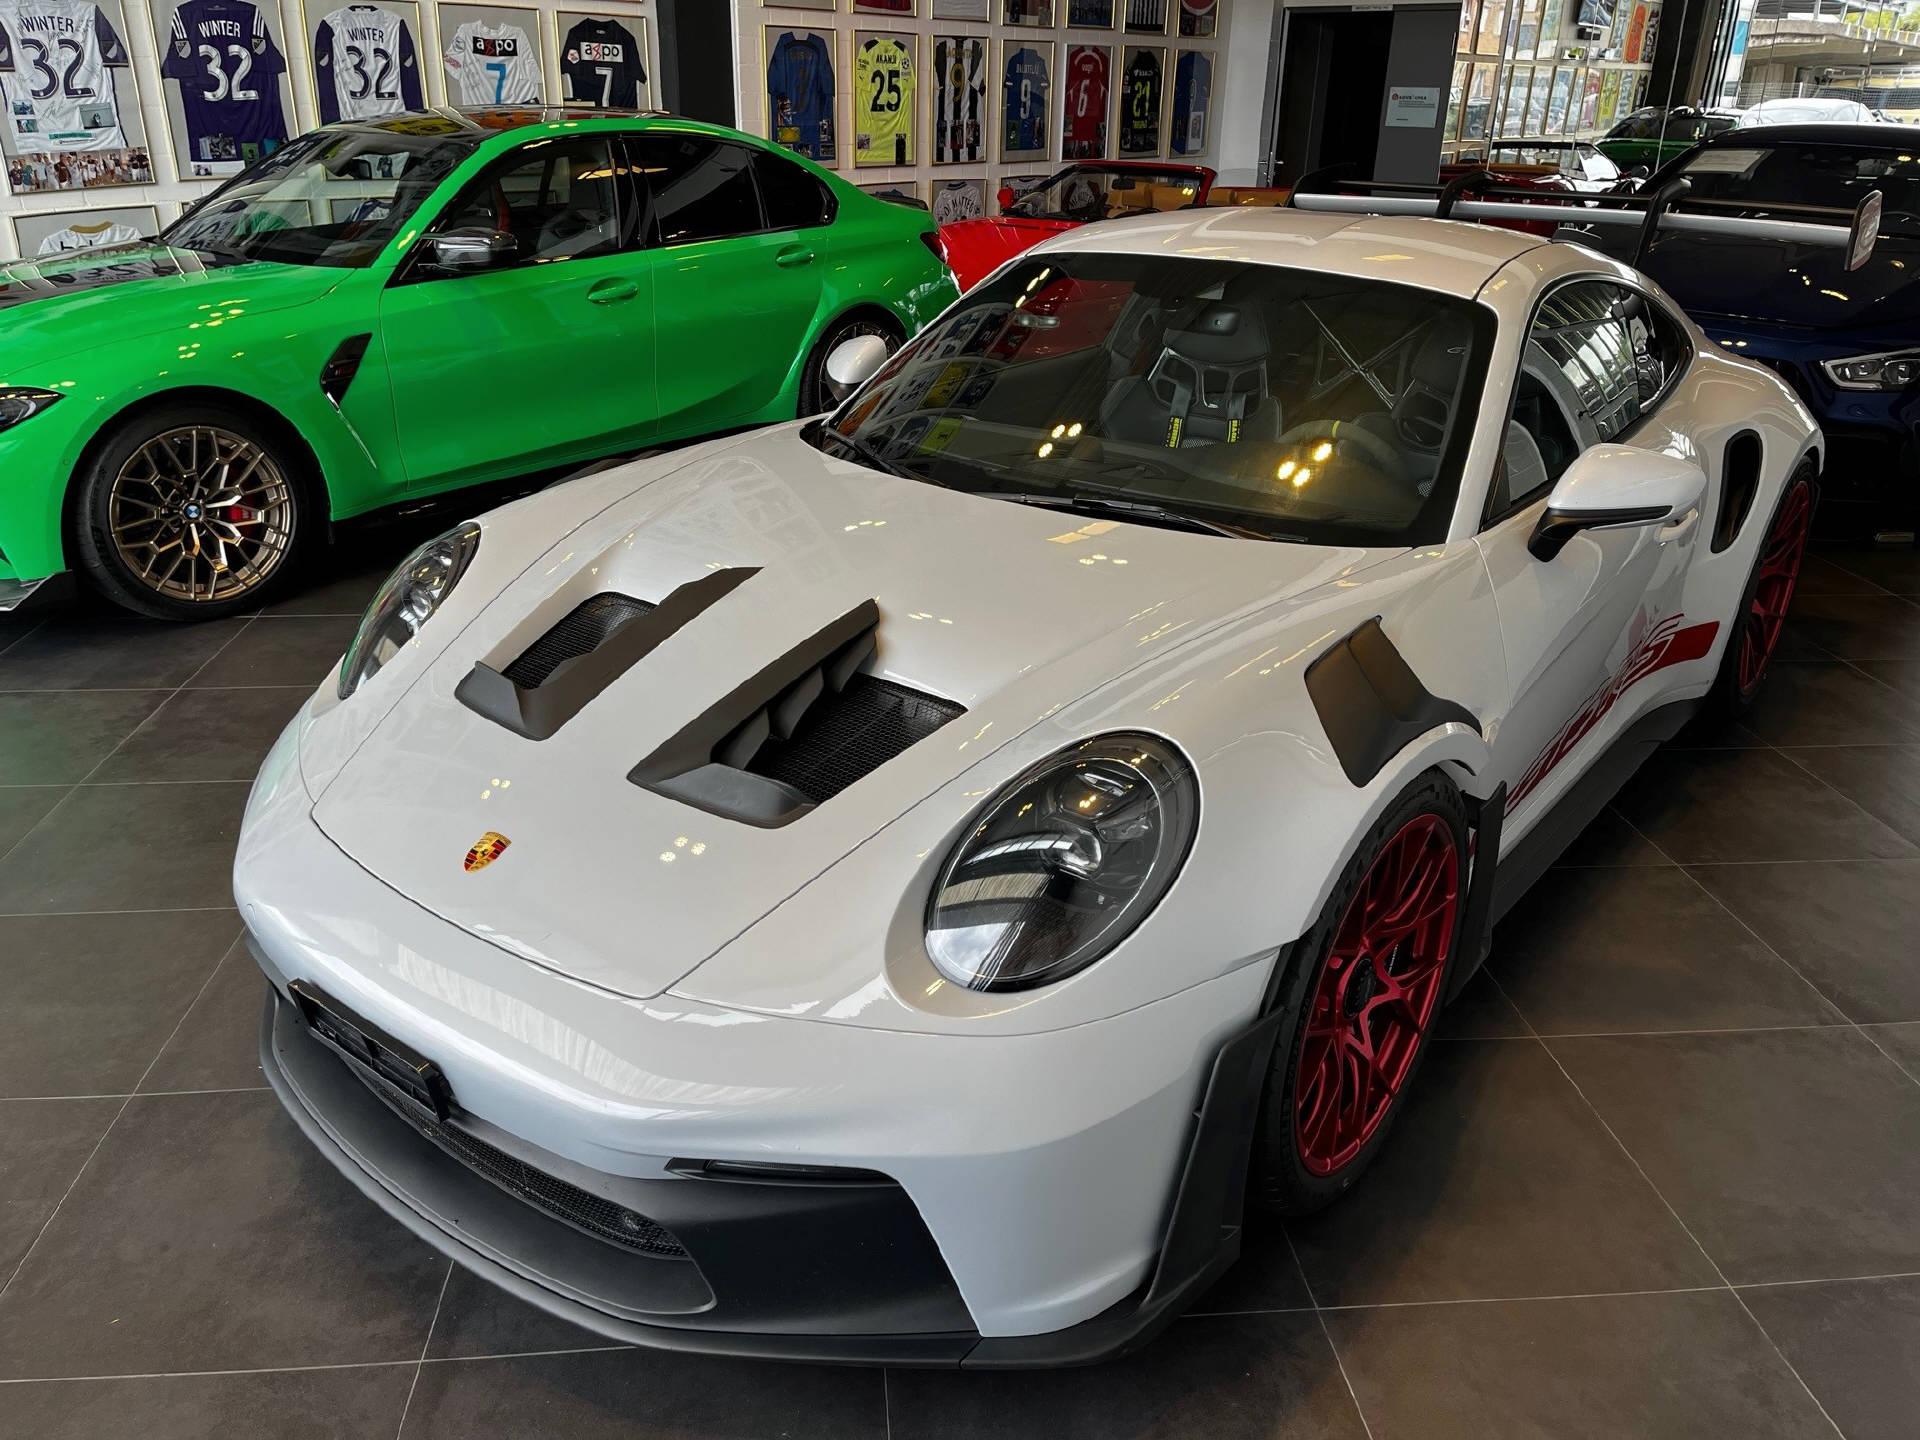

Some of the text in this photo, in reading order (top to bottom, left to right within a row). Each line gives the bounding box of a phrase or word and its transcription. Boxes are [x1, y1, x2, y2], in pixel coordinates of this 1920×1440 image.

[21, 15, 75, 33] WINTER
[198, 20, 241, 38] WINTER
[347, 26, 385, 43] WINTER
[20, 38, 96, 100] 32
[198, 44, 260, 101] 32
[346, 45, 399, 100] 32
[876, 53, 897, 65] AKANJI
[485, 63, 507, 104] 7
[595, 67, 614, 107] 7
[870, 69, 901, 112] 25
[950, 62, 965, 103] 9
[1020, 78, 1032, 120] 9
[1077, 78, 1091, 118] 6
[1132, 80, 1151, 118] 21
